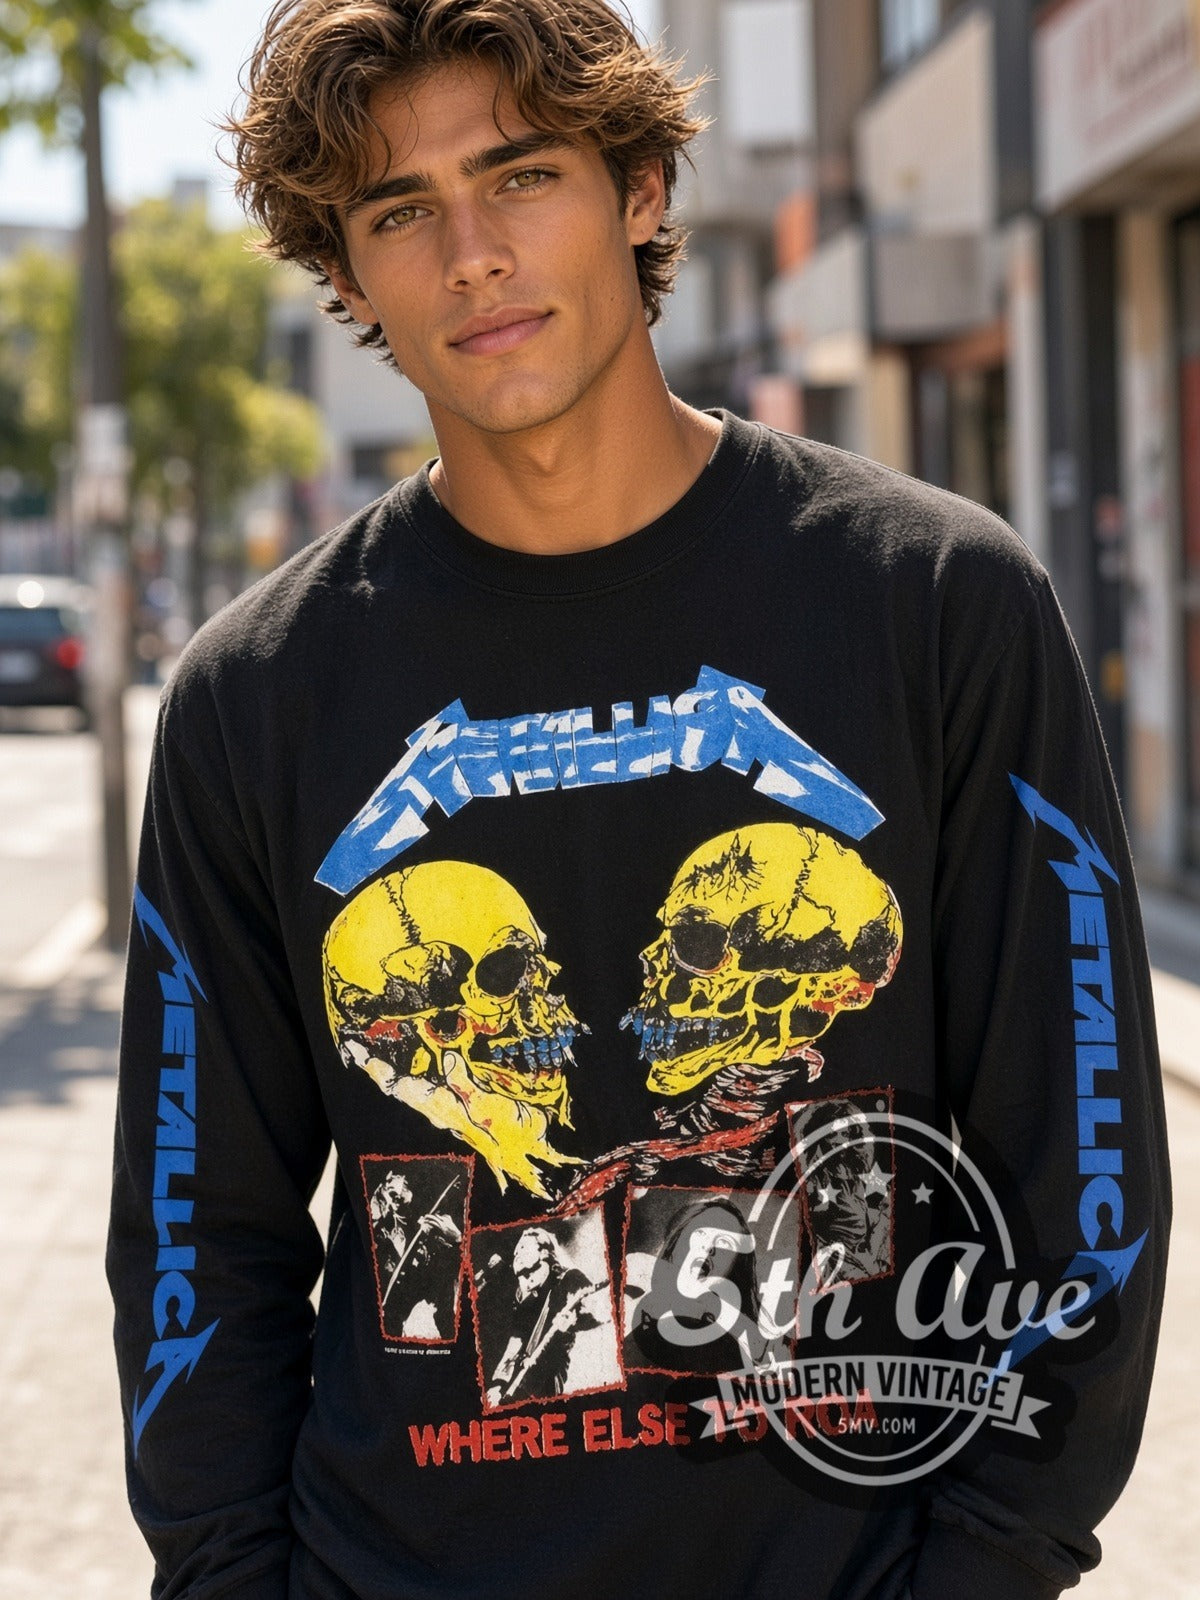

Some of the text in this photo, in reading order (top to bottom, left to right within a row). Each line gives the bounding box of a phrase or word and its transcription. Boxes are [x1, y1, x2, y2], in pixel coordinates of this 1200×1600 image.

[133, 878, 221, 1462] METALLICA
[977, 771, 1150, 1393] METALLICA
[408, 1413, 569, 1467] WHERE
[583, 1403, 691, 1452] ELSE
[703, 1397, 768, 1442] TO
